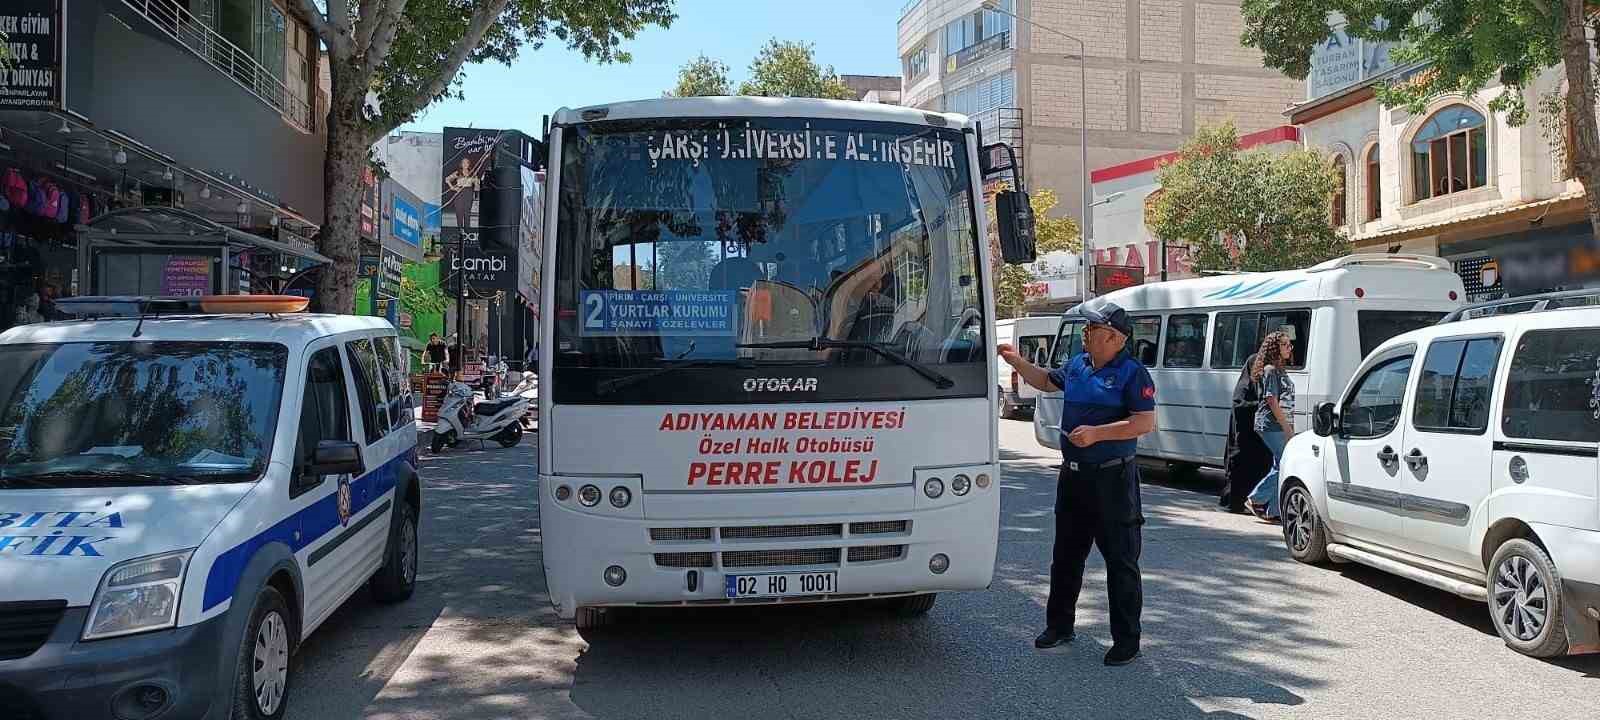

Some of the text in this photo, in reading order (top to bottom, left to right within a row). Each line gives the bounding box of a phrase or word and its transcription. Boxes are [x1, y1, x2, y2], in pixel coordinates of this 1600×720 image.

[21, 12, 50, 35] GİYİM
[31, 43, 38, 61] &
[12, 65, 53, 87] DÜNYASI
[451, 255, 507, 271] bambi
[585, 293, 604, 328] 2
[609, 304, 727, 318] YURTLAR KURUMU
[743, 377, 818, 392] OTOKAR
[659, 407, 906, 432] ADIYAMAN BELEDİYESİ
[699, 433, 874, 455] Özel Halk Otobüsü
[687, 459, 879, 486] PERRE KOLEJ
[738, 576, 757, 595] 02
[799, 573, 831, 592] 1001
